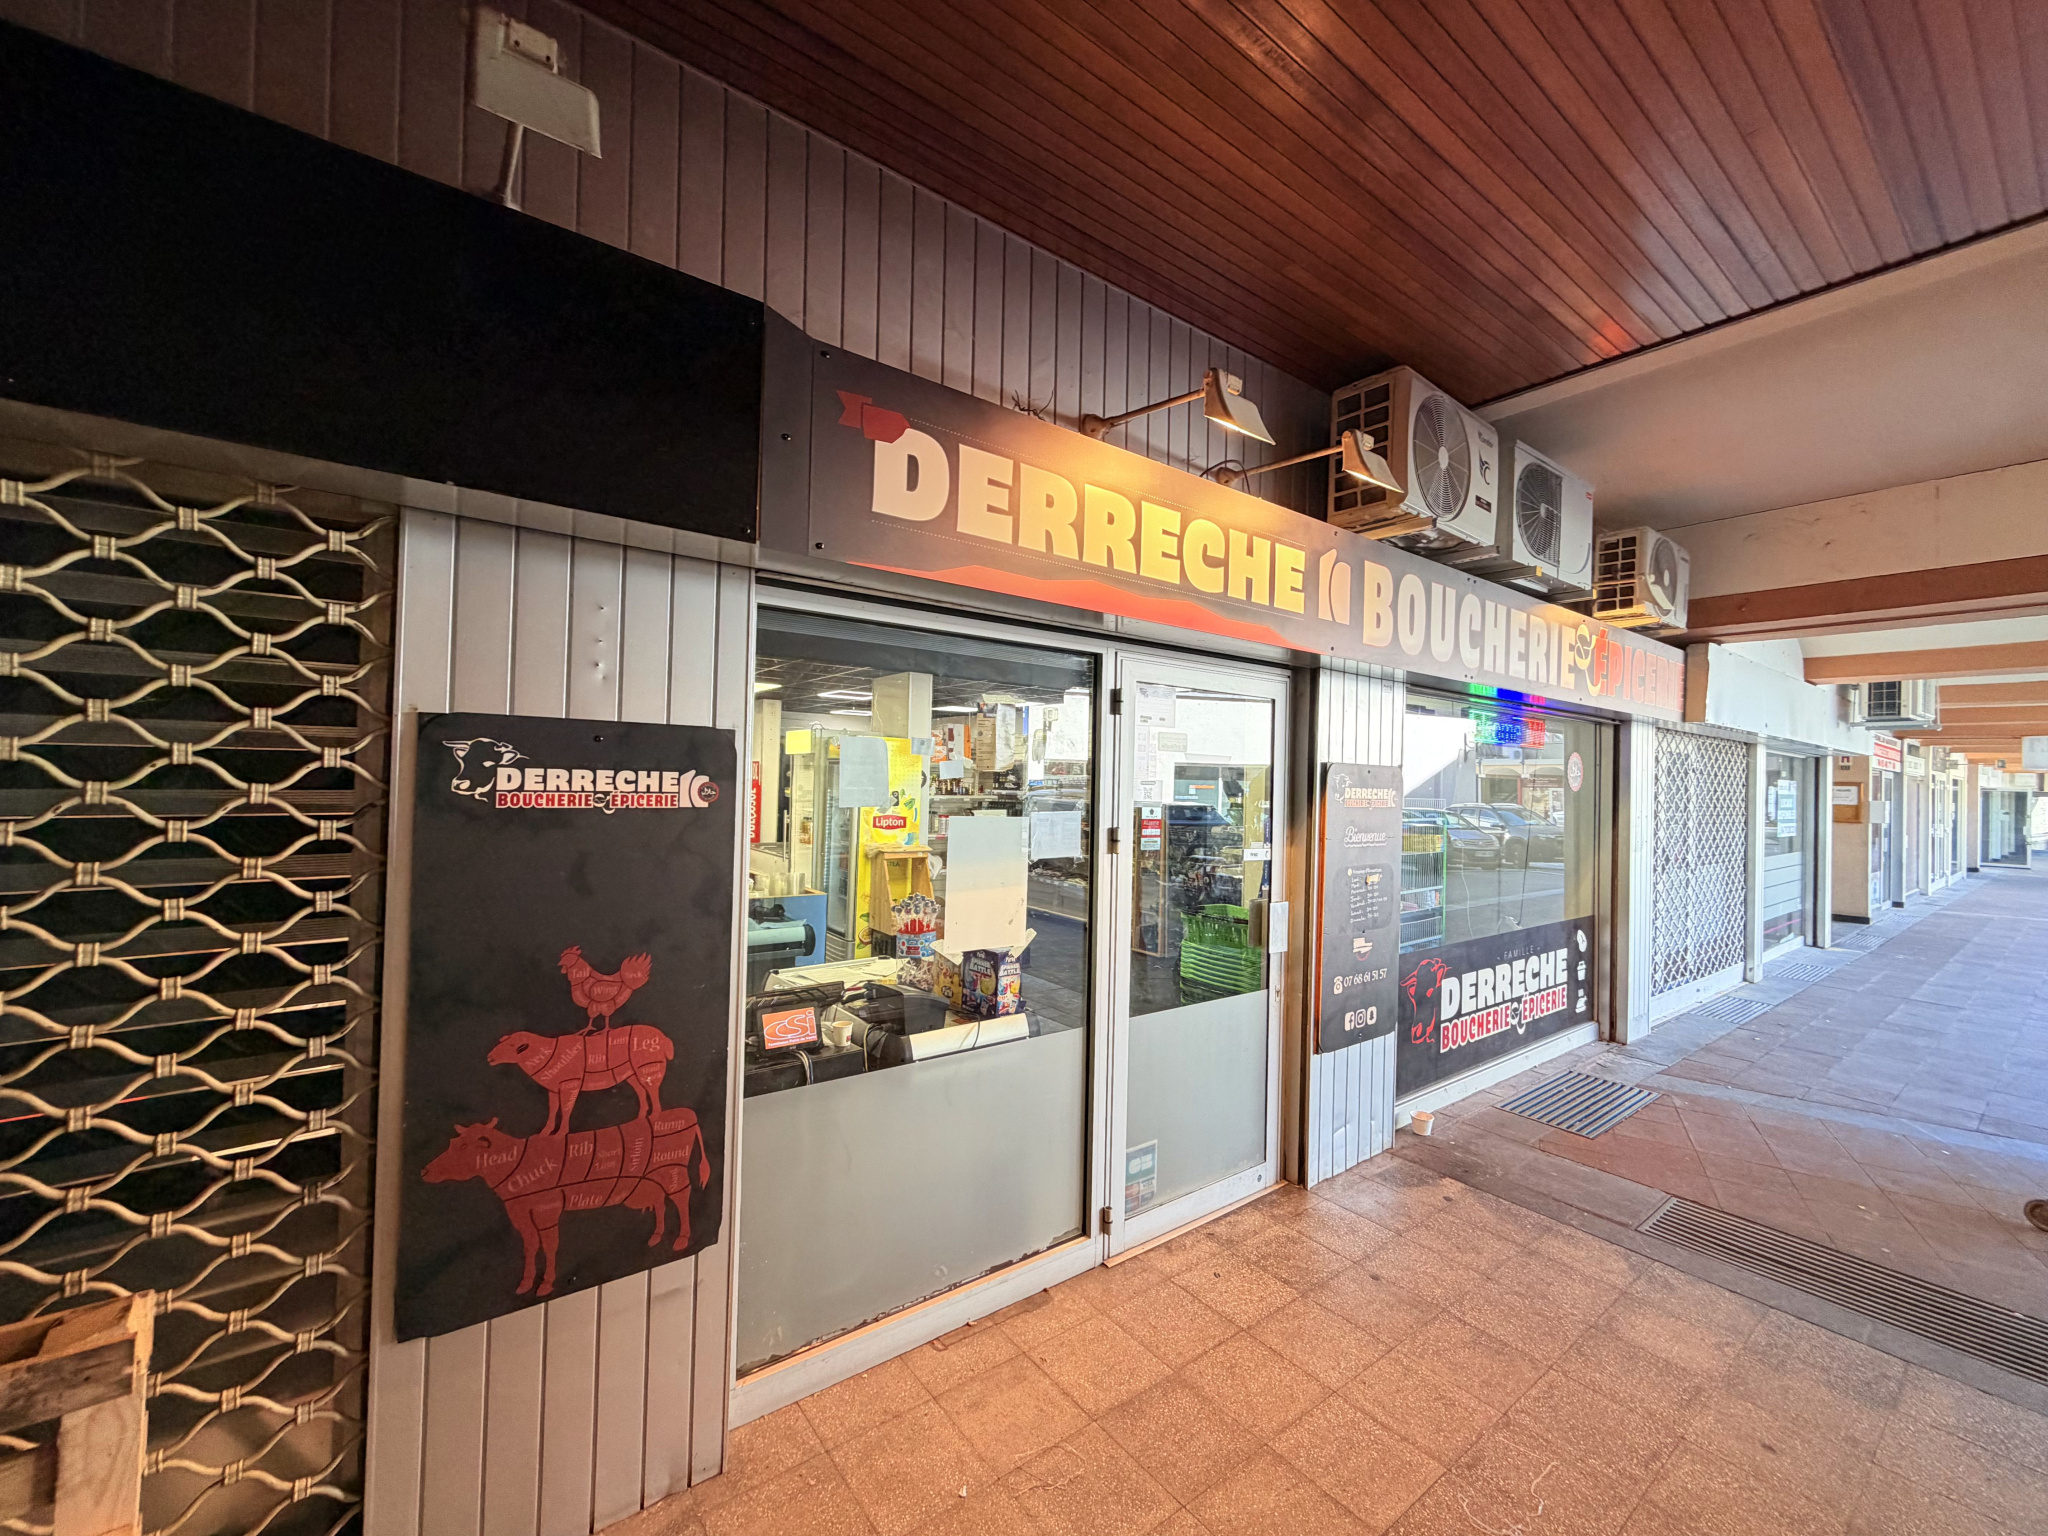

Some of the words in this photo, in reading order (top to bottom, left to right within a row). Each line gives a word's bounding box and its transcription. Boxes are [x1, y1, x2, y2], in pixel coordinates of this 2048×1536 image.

[872, 428, 1305, 614] DERRECHE
[1362, 560, 1575, 690] BOUCHERIE
[1594, 627, 1684, 712] ÉPICERIE
[496, 767, 679, 792] DERRECHE
[496, 791, 593, 808] BOUCHERIE
[609, 790, 679, 808] ÉPICERIE
[1344, 787, 1389, 799] DERRECHE
[875, 817, 904, 828] Lipton
[1343, 825, 1386, 843] Bienvenue
[1504, 945, 1534, 960] FAMILLE
[1343, 976, 1353, 987] 07
[1353, 973, 1363, 985] 68
[1363, 971, 1371, 982] 61
[1372, 970, 1378, 981] 51
[1379, 968, 1387, 979] 57
[1441, 948, 1568, 1020] DERRECHE
[1440, 1002, 1511, 1053] BOUCHERIE
[1521, 984, 1568, 1024] ÉPICERIE
[632, 1036, 660, 1052] Leg
[525, 1046, 552, 1068] Neck
[540, 1042, 583, 1081] Shoulder
[588, 1053, 606, 1065] Rib
[654, 1119, 685, 1131] Rump
[476, 1146, 518, 1170] Head
[569, 1141, 593, 1158] Rib
[629, 1137, 644, 1171] Sirloin
[653, 1146, 689, 1163] Round
[507, 1157, 558, 1193] Chuck
[570, 1193, 602, 1208] Plate
